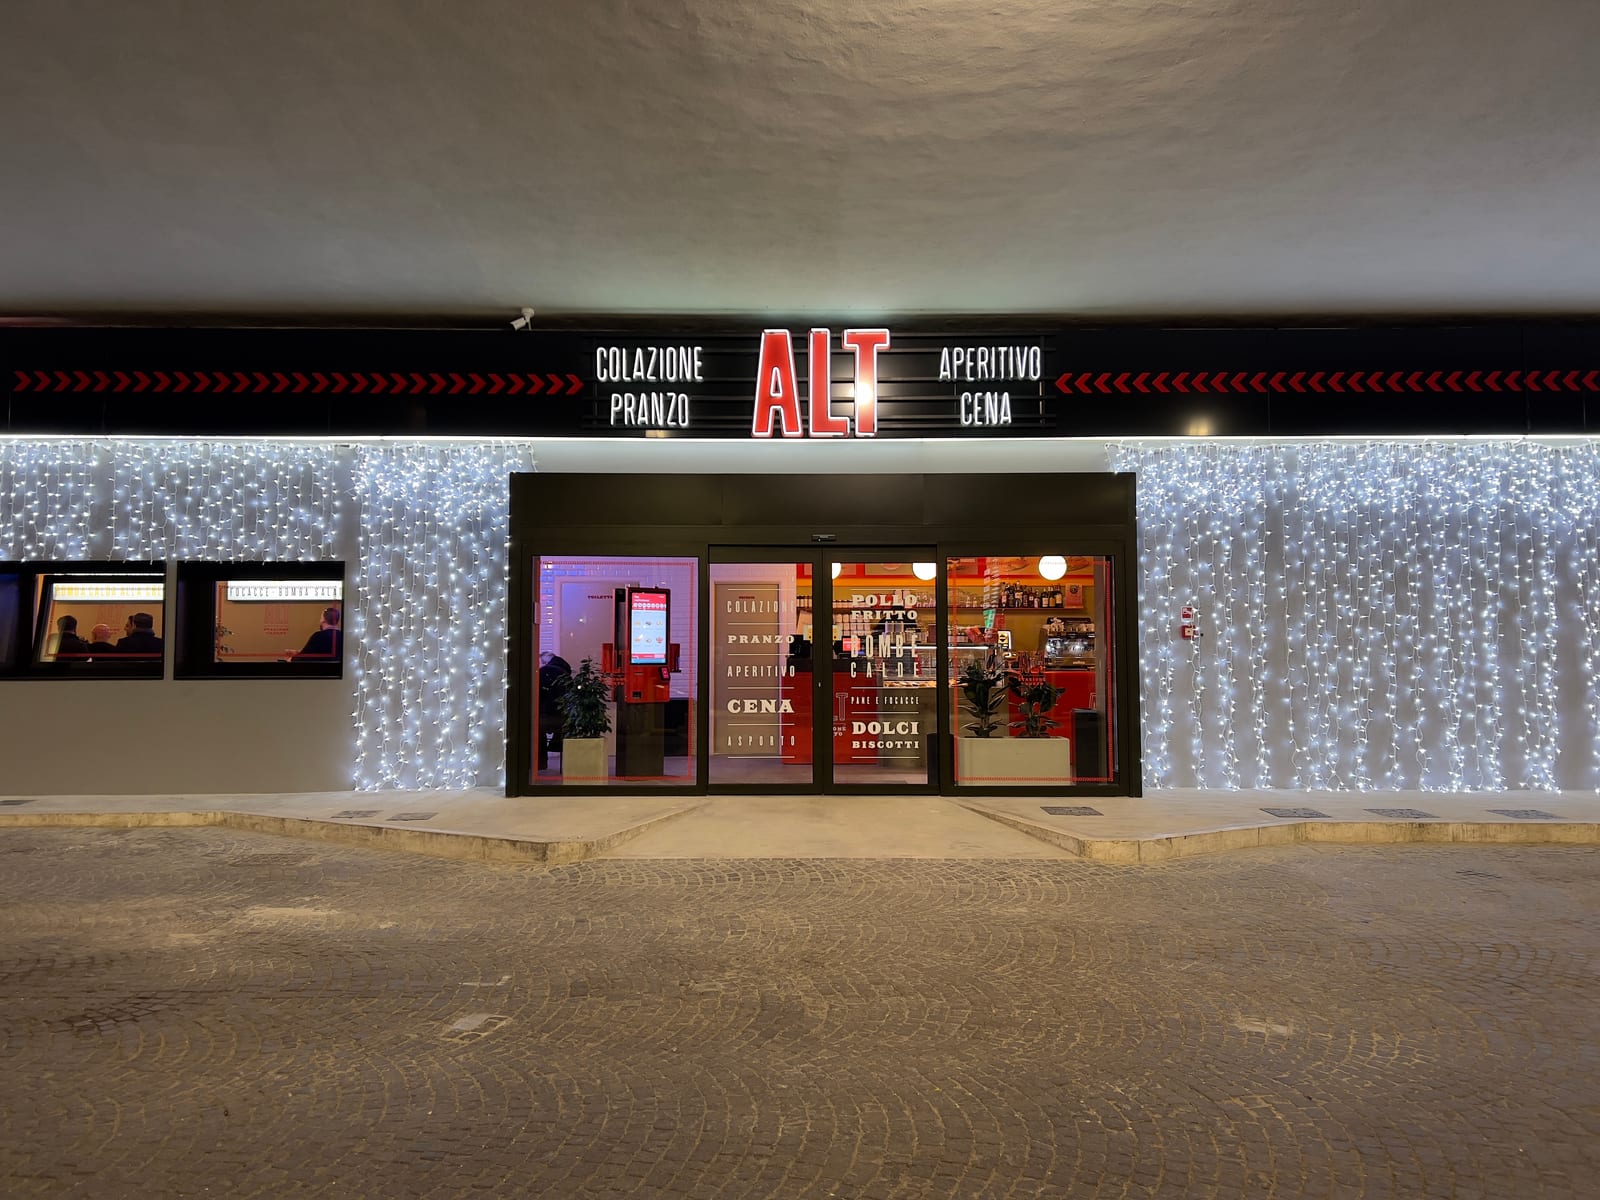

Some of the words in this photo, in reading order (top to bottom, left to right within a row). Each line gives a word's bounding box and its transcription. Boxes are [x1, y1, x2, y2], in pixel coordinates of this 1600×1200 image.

[595, 345, 704, 383] COLAZIONE
[938, 345, 1042, 382] APERITIVO
[751, 327, 891, 438] ALT
[609, 392, 690, 428] PRANZO
[960, 391, 1013, 426] CENA
[727, 600, 796, 613] COLAZIONE
[851, 594, 918, 607] POLLO
[851, 610, 918, 620] FRITTO
[727, 634, 795, 644] PRANZO
[850, 634, 919, 658] BOMBE
[727, 665, 795, 677] APERITIVO
[850, 661, 919, 678] CALDE
[727, 698, 795, 714] CENA
[850, 696, 870, 705] PANE
[875, 696, 880, 705] E
[884, 696, 919, 705] FOCACCE
[851, 721, 919, 735] DOLCI
[727, 735, 795, 747] ASPORTO
[851, 740, 919, 749] BISCOTTI
